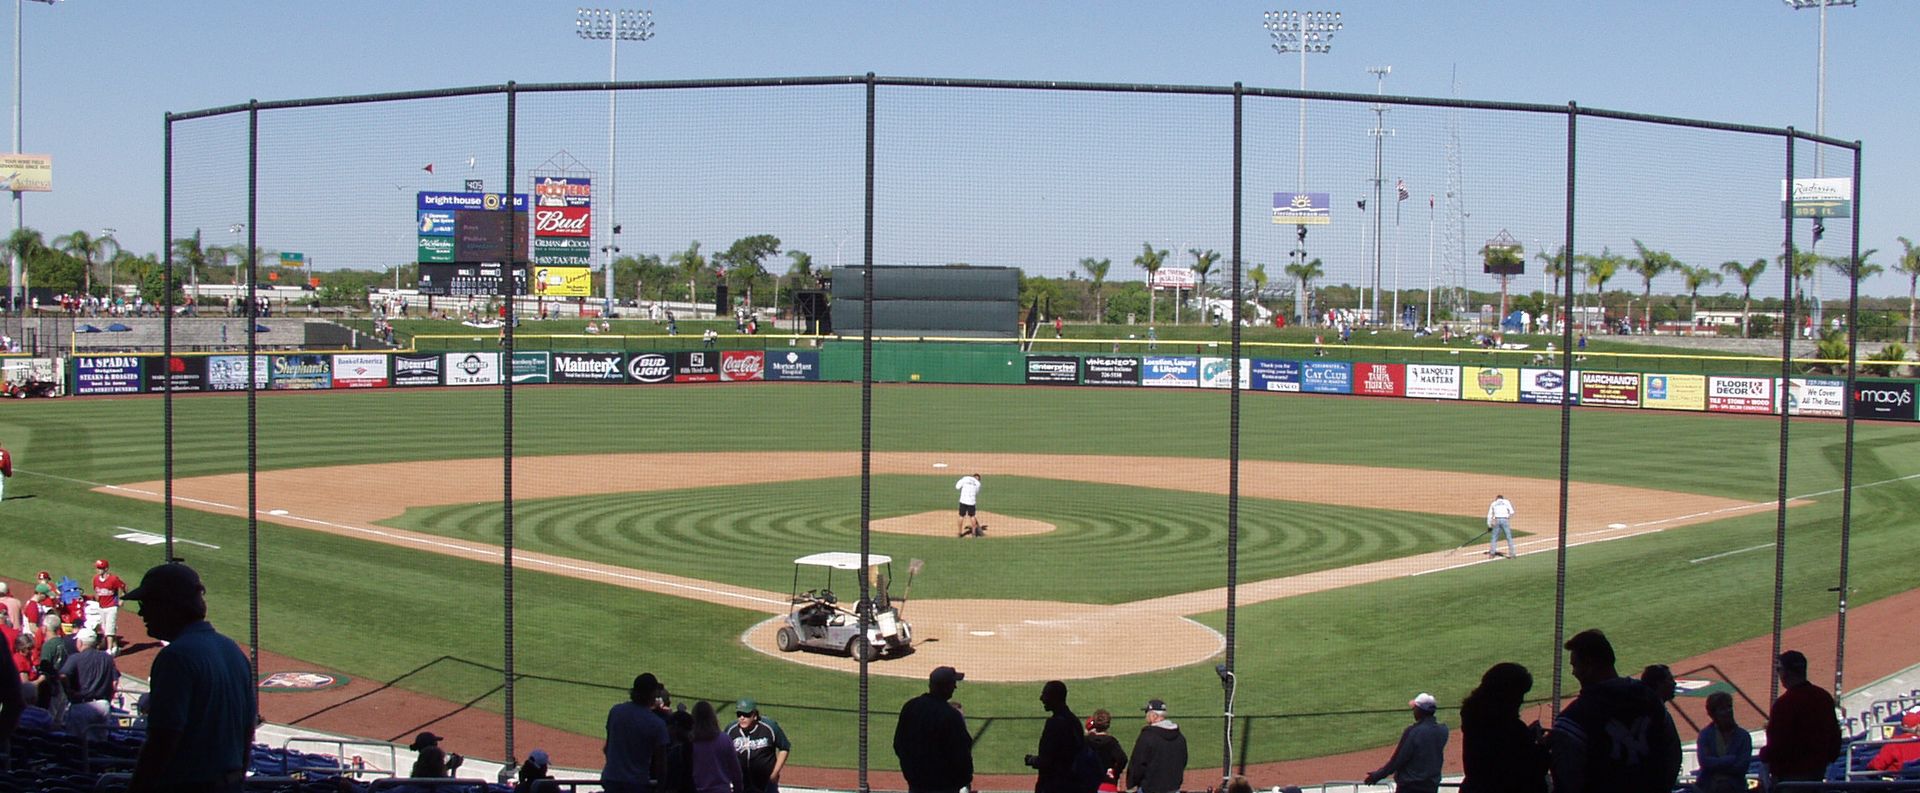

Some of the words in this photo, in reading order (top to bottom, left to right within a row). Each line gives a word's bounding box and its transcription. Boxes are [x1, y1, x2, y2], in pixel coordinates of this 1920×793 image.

[425, 195, 453, 206] bright
[454, 196, 481, 204] house
[502, 197, 522, 205] fld
[537, 211, 588, 231] Bud
[80, 357, 94, 368] LA
[94, 357, 138, 368] SPADA'S
[639, 358, 666, 367] BUD
[635, 367, 670, 376] LIGHT
[1160, 366, 1187, 374] Lifestyle
[1371, 364, 1388, 373] THE
[1420, 368, 1454, 376] BANQUET
[1324, 369, 1347, 379] CLUB
[1368, 372, 1390, 381] TAMPA
[1420, 376, 1454, 384] MASTERS
[1364, 381, 1394, 389] TRIBUNE
[1807, 388, 1816, 396] We
[1818, 389, 1836, 397] Cover
[1812, 397, 1823, 405] The
[1825, 398, 1840, 406] Bases
[1861, 389, 1911, 406] macy's
